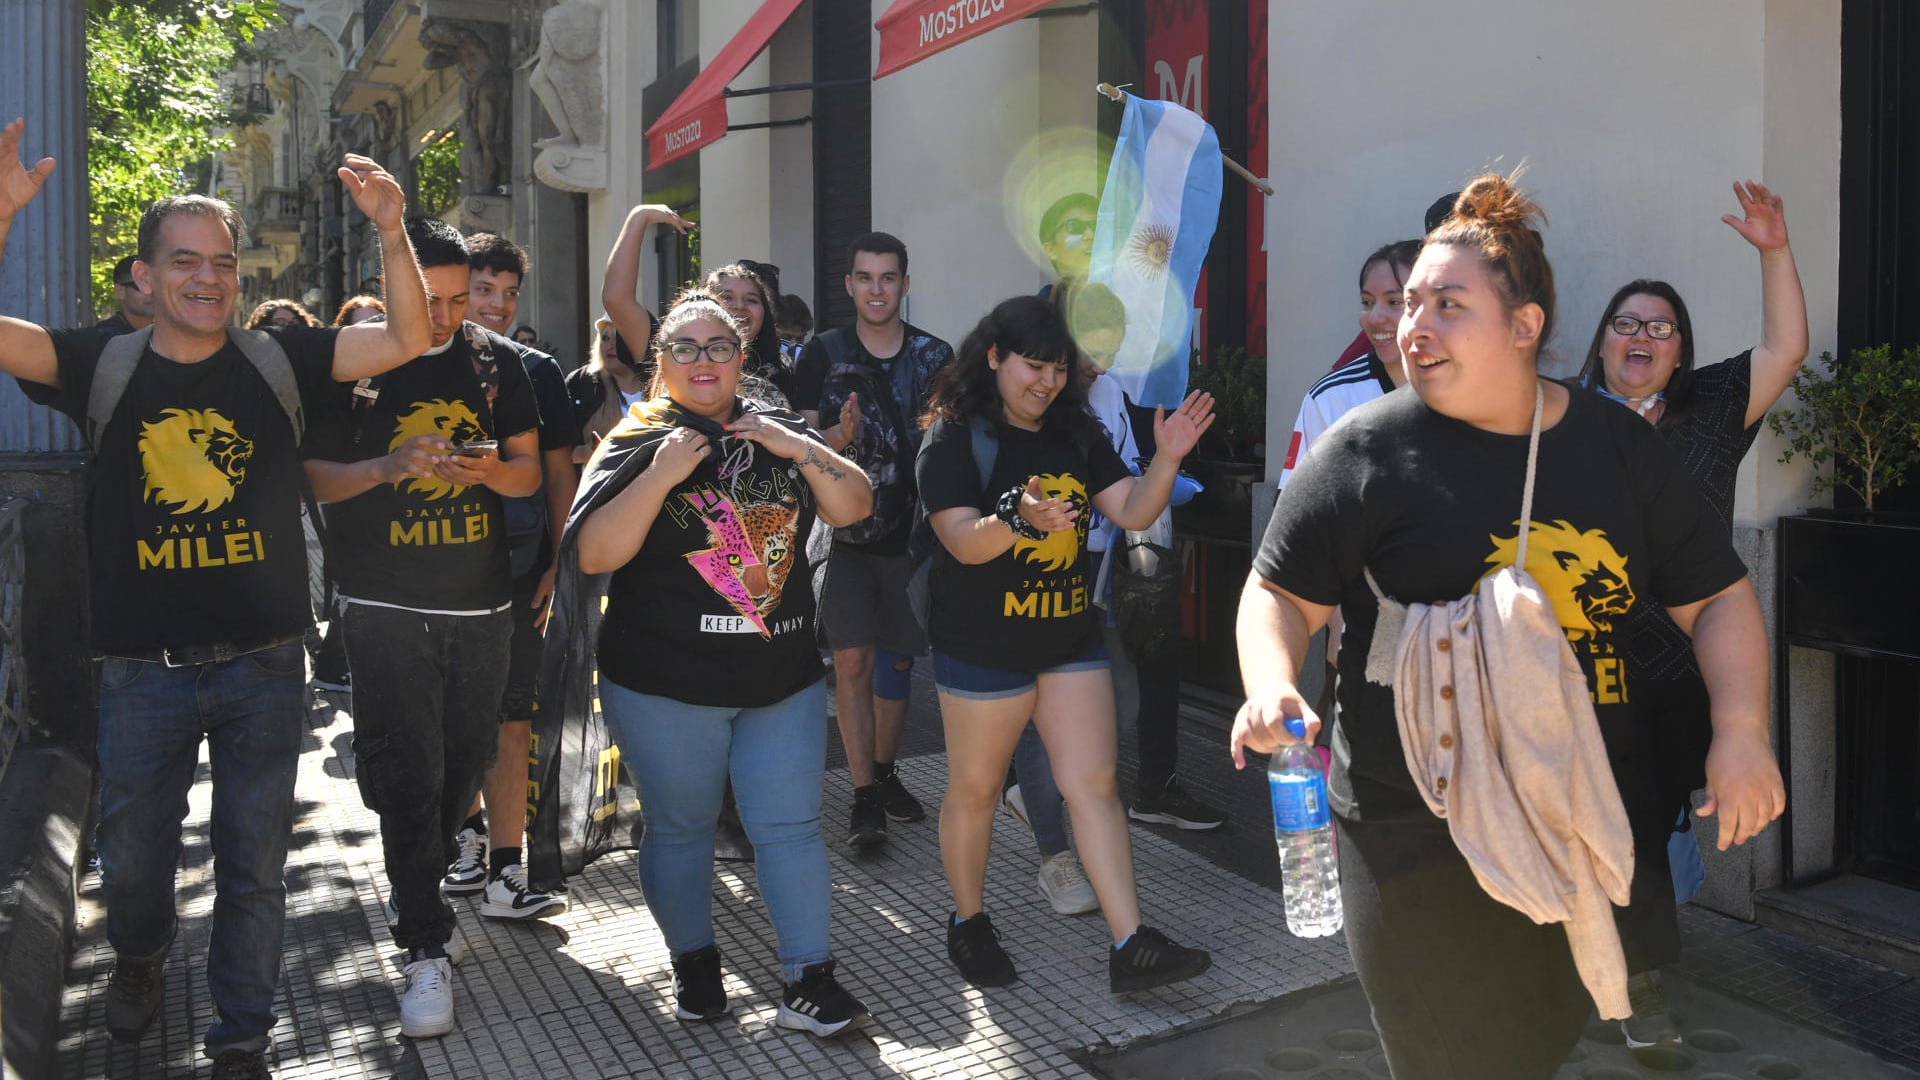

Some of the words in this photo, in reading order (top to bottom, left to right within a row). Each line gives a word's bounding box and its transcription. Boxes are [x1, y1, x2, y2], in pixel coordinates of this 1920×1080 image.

[155, 518, 246, 535] JAVIER
[389, 512, 489, 547] MILEI
[136, 530, 265, 571] MILEI
[1003, 584, 1089, 618] MILEI
[705, 617, 744, 632] KEEP
[773, 616, 803, 636] AWAY
